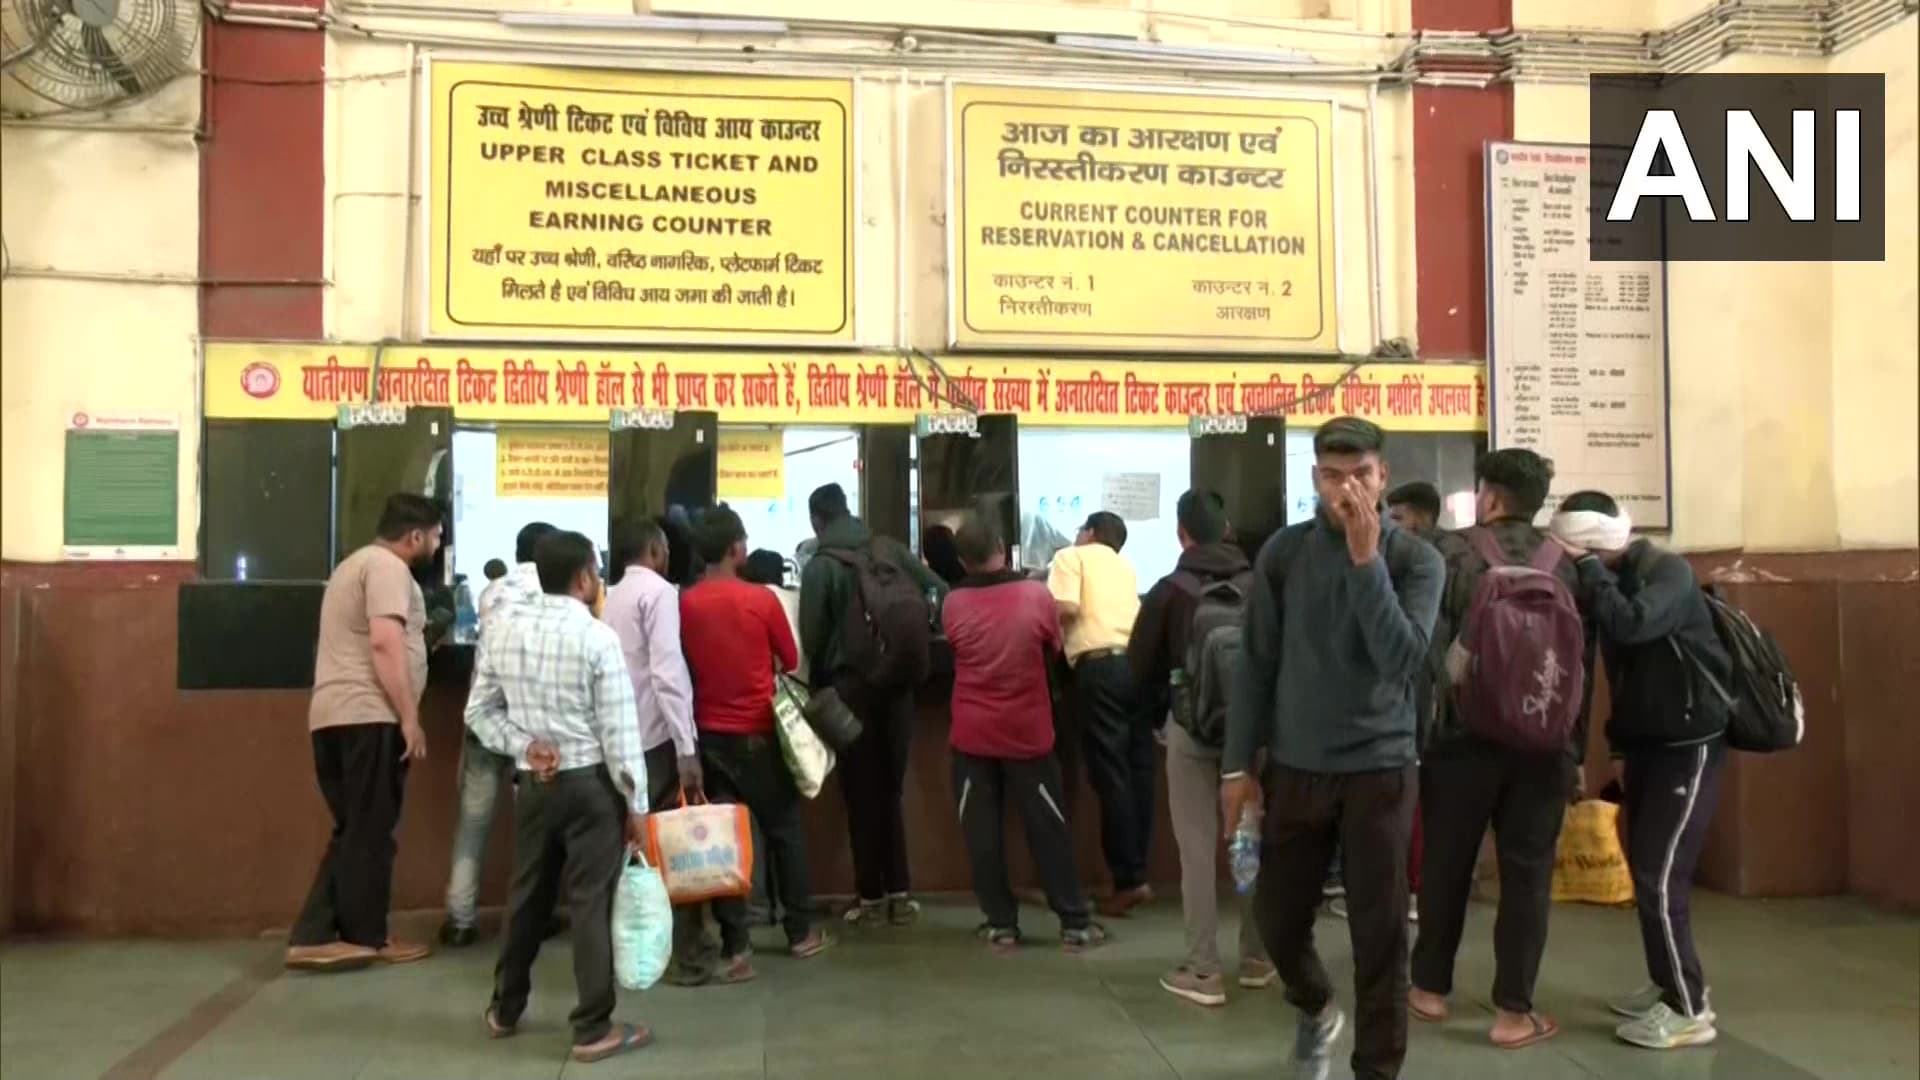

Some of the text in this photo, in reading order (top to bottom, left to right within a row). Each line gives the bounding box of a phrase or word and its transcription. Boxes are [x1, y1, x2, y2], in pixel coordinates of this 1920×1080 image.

[476, 101, 821, 141] उच्च श्रेणी टिकट एवं विविध आय काउन्टर
[1002, 123, 1282, 154] आज का आरक्षण एवं
[481, 142, 818, 173] UPPER CLASS TICKET AND
[1178, 165, 1285, 188] काउन्टर
[546, 180, 756, 205] MISCELLANEOUS
[529, 211, 771, 236] EARNING COUNTER
[1020, 201, 1267, 229] CURRENT COUNTER FOR
[982, 227, 1304, 254] RESERVATION & CANCELLATION
[472, 243, 503, 266] यहाँ
[505, 250, 526, 265] पर
[530, 251, 560, 266] उच्च
[784, 252, 823, 274] टिकट
[502, 277, 546, 300] मिलते
[566, 280, 590, 302] एवं
[592, 280, 635, 301] विविध
[640, 288, 670, 302] आय
[675, 289, 707, 303] जमा
[712, 283, 732, 304] की
[737, 285, 772, 305] जाती
[992, 272, 1054, 290] काउन्टर
[1088, 274, 1095, 291] 1
[1192, 279, 1251, 295] काउन्टर
[1281, 280, 1292, 296] 2
[1216, 305, 1271, 321] आरक्षण
[457, 358, 497, 404] टिकट
[556, 360, 590, 405] श्रेणी
[595, 361, 625, 406] हॉल
[631, 361, 644, 406] से
[652, 362, 669, 406] भी
[675, 372, 708, 408] प्राप्त
[713, 373, 735, 407] कर
[741, 363, 778, 407] सकते
[856, 364, 888, 407] श्रेणी
[993, 367, 1031, 412] संख्या
[1036, 369, 1050, 413] में
[1125, 372, 1159, 414] टिकट
[1164, 383, 1211, 415] काउन्टर
[1216, 371, 1236, 415] एवं
[1302, 374, 1336, 415] टिकट
